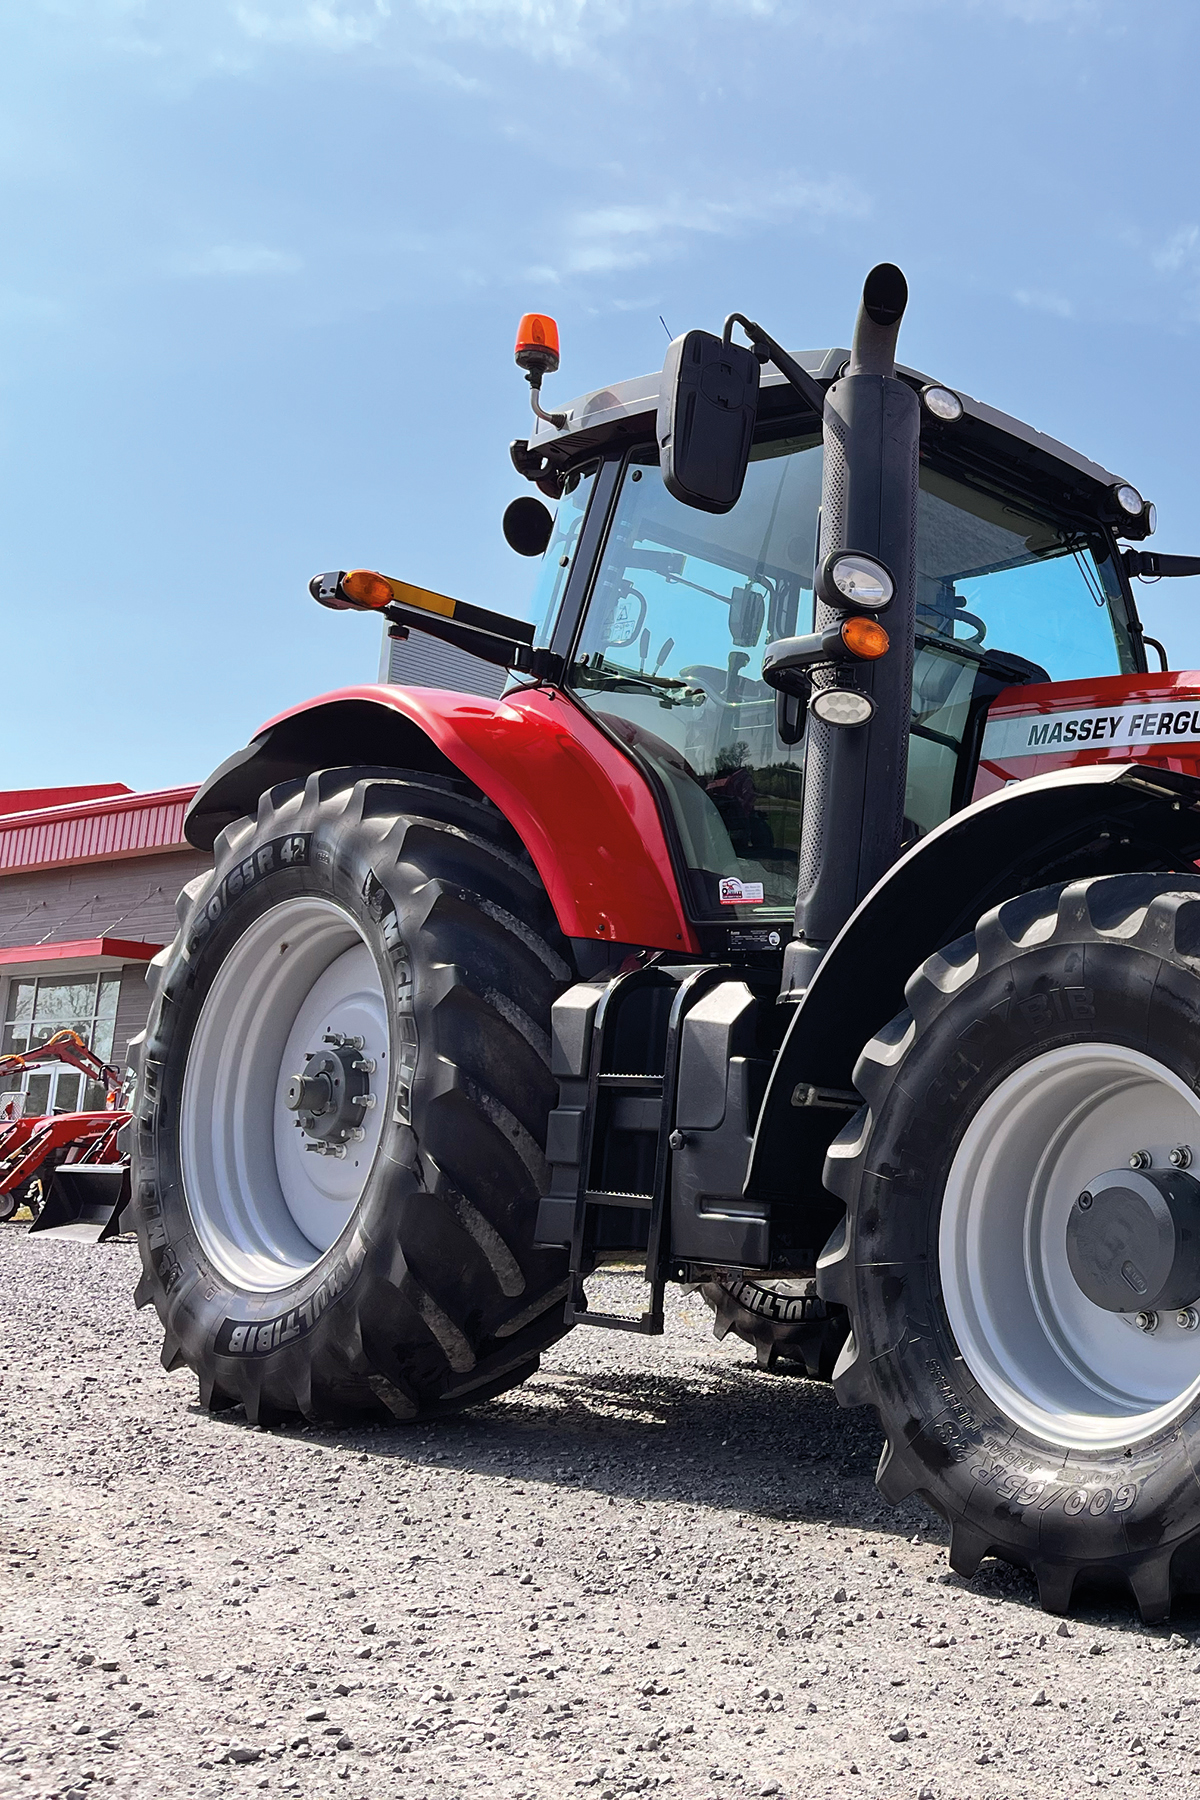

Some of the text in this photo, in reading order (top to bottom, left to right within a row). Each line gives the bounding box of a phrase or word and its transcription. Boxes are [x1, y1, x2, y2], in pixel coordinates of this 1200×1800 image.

[1027, 714, 1124, 748] MASSEY
[280, 836, 306, 864] 42
[229, 1258, 352, 1353] MULTIBIB
[925, 1357, 1044, 1475] RADIAL TUBELESS
[931, 1419, 979, 1464] 28
